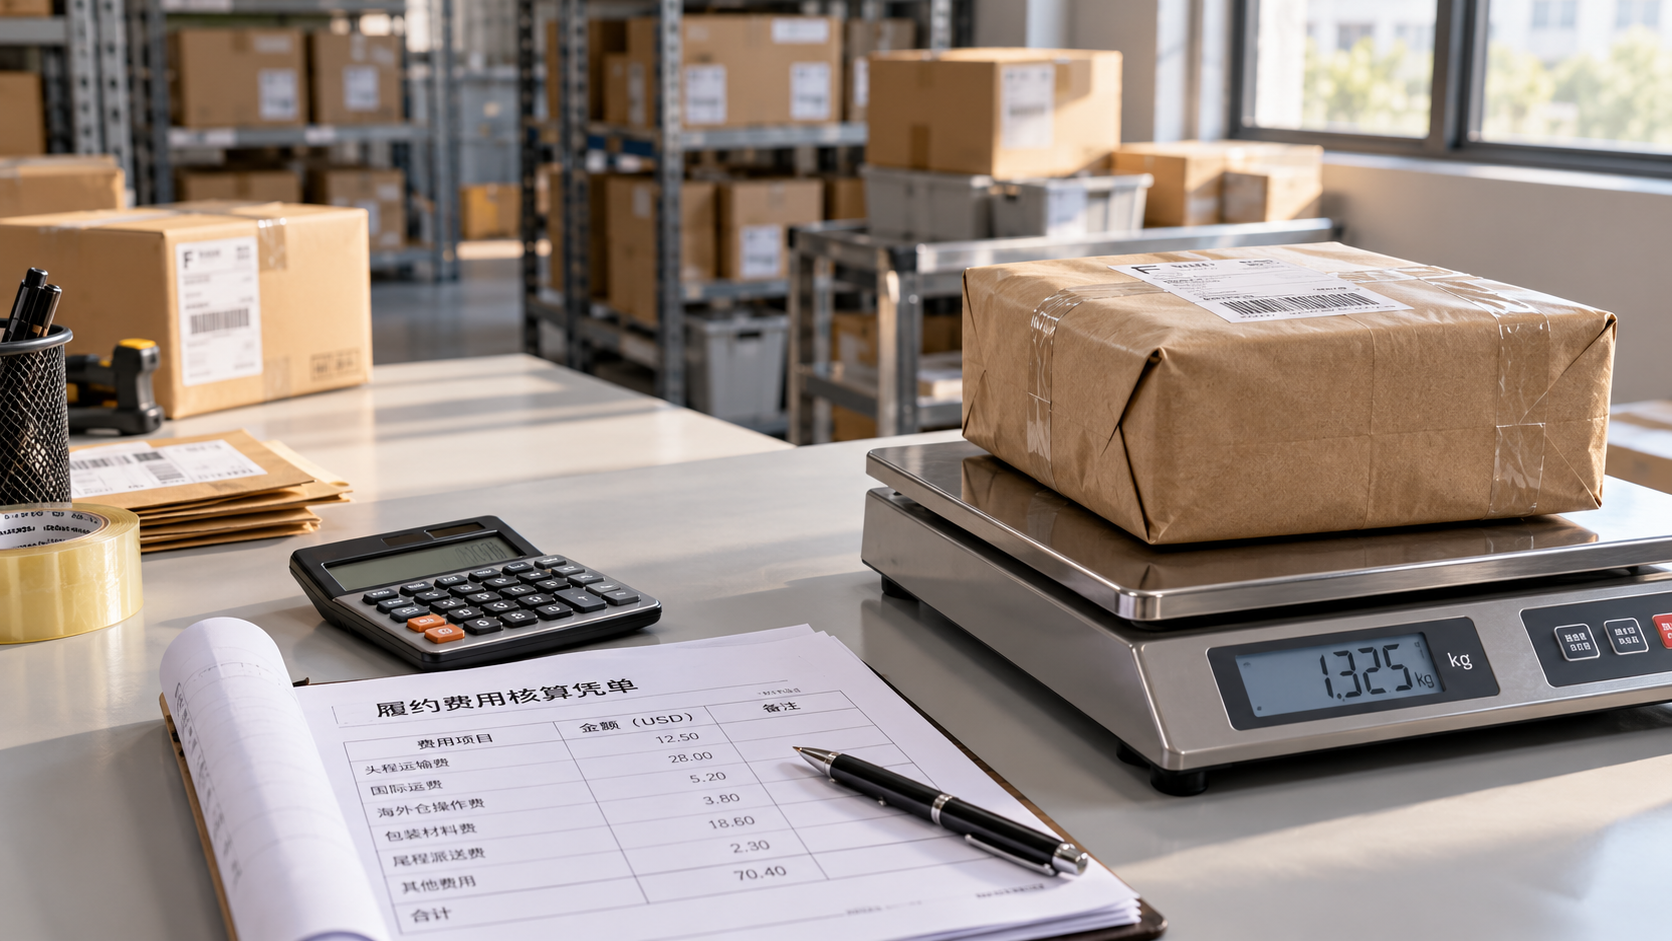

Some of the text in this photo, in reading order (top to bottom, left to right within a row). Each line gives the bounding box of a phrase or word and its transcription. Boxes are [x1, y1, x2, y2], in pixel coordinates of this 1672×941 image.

[1447, 652, 1473, 670] kg
[1319, 643, 1435, 701] 1.325 kg
[377, 678, 639, 718] 履约费用核算凭单
[762, 701, 801, 714] 备注
[417, 733, 494, 750] 费用项目
[655, 732, 700, 745] 12.50
[668, 751, 713, 765] 28.00
[689, 771, 727, 784] 5.20
[370, 780, 444, 796] 国际运费
[702, 793, 741, 806] 3.80
[377, 798, 485, 819] 海外仓操作费
[708, 815, 756, 830] 18.60
[385, 823, 478, 842] 包装材料费
[729, 839, 771, 854] 2.30
[393, 847, 486, 867] 尾程派送费
[733, 865, 787, 881] 70.40
[402, 875, 477, 894] 其他费用
[410, 906, 452, 923] 合计
